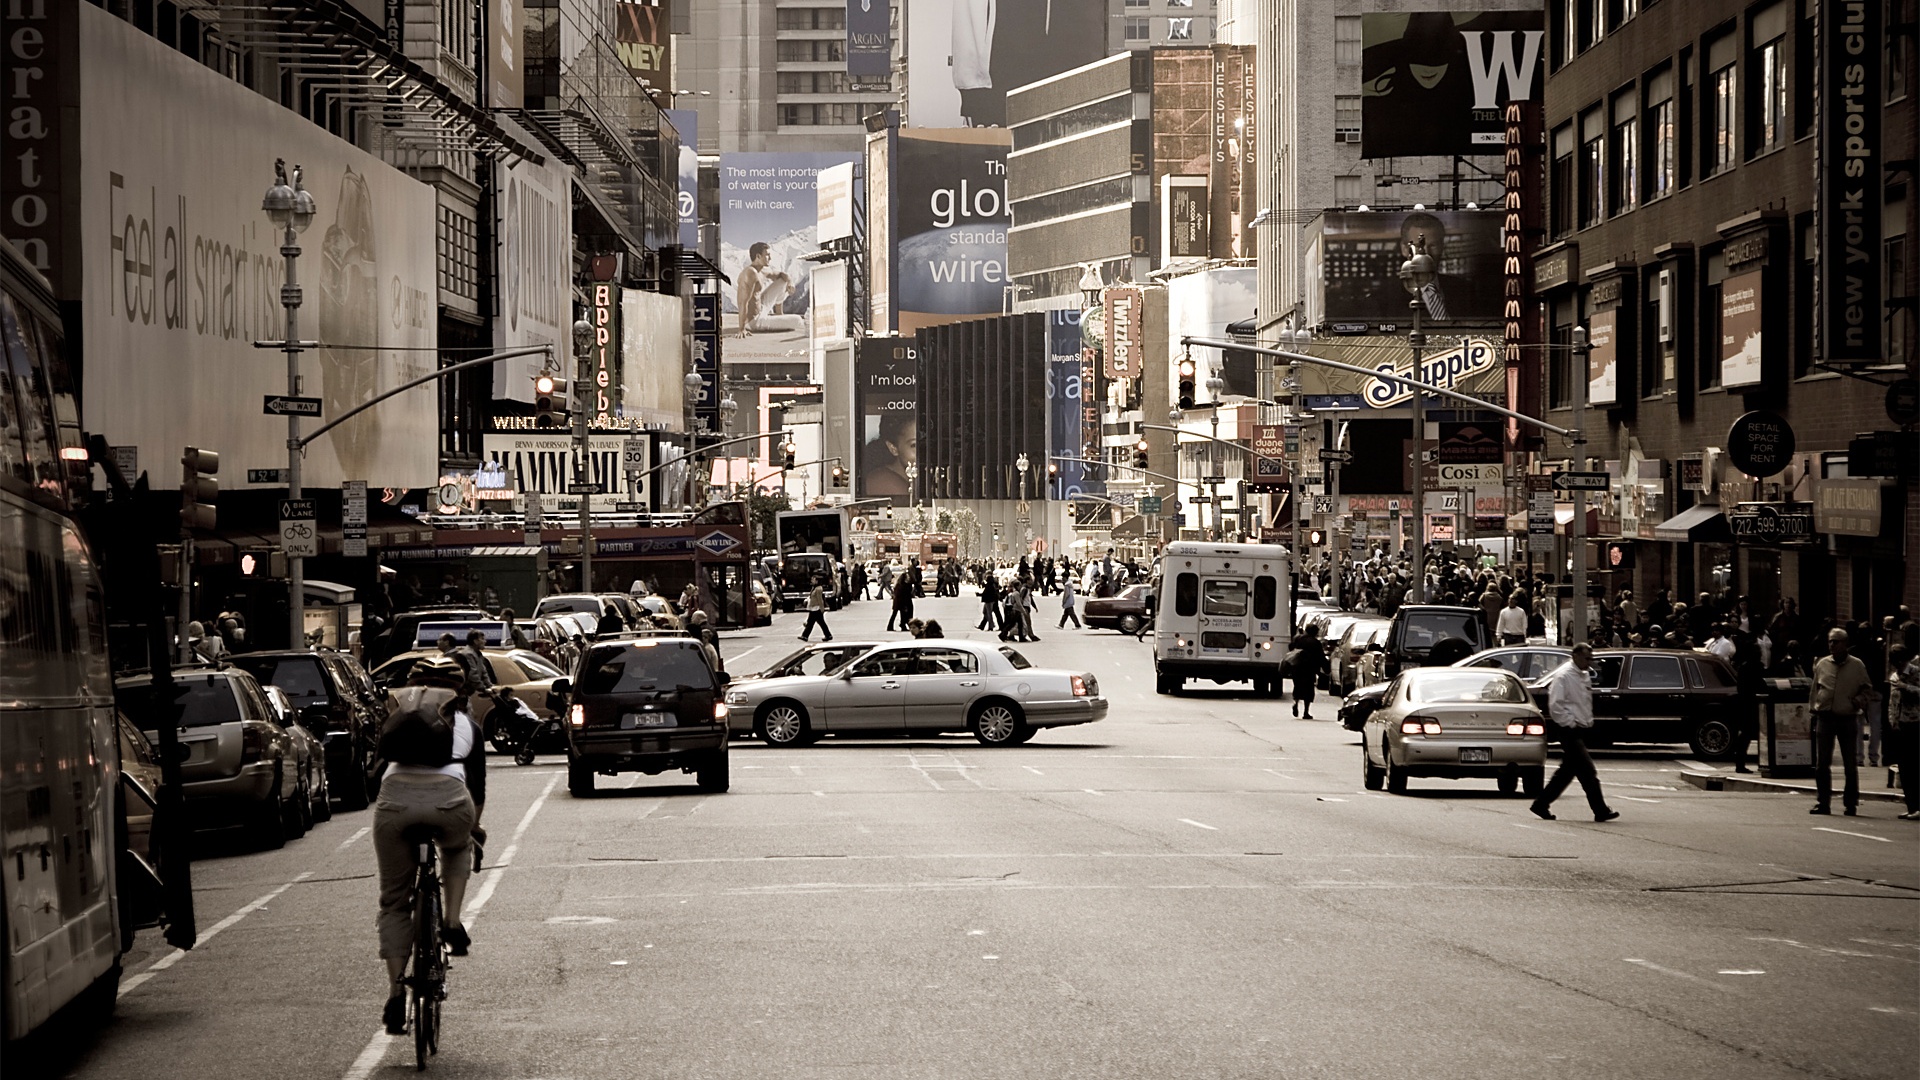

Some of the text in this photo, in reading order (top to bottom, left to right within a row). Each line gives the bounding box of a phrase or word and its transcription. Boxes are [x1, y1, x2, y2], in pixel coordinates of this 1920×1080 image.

[850, 31, 887, 45] ARGENT
[1840, 63, 1871, 178] sports
[727, 167, 826, 179] The most importa
[985, 160, 1007, 175] Th
[728, 180, 738, 190] of
[741, 181, 770, 190] water
[773, 180, 782, 190] is
[785, 182, 808, 191] your
[728, 200, 742, 209] Fill
[745, 200, 767, 209] with
[1840, 188, 1870, 265] york
[950, 229, 1007, 244] standa
[109, 171, 157, 325] Feel
[164, 194, 188, 330] all
[194, 223, 249, 342] smart
[1846, 276, 1864, 347] new
[1114, 296, 1133, 373] Twizzlers
[1052, 354, 1075, 364] Morgan
[1372, 339, 1485, 401] Snapple
[871, 374, 891, 385] I'm
[272, 401, 315, 411] ONE WAY
[1748, 423, 1780, 433] RETAIL
[1749, 433, 1779, 442] SPACE
[515, 441, 533, 449] BENNY
[535, 441, 569, 449] ANDERSSON
[1754, 444, 1774, 452] FOR
[1256, 447, 1283, 455] reade
[625, 452, 641, 462] 30
[1750, 454, 1776, 463] RENT
[250, 471, 257, 481] W
[258, 470, 267, 481] 52
[1442, 466, 1479, 480] Così
[289, 545, 310, 553] ONLY
[601, 542, 634, 552] PARTNER
[388, 551, 400, 560] MY
[402, 549, 436, 559] RUNNING
[438, 548, 471, 557] PARTNER
